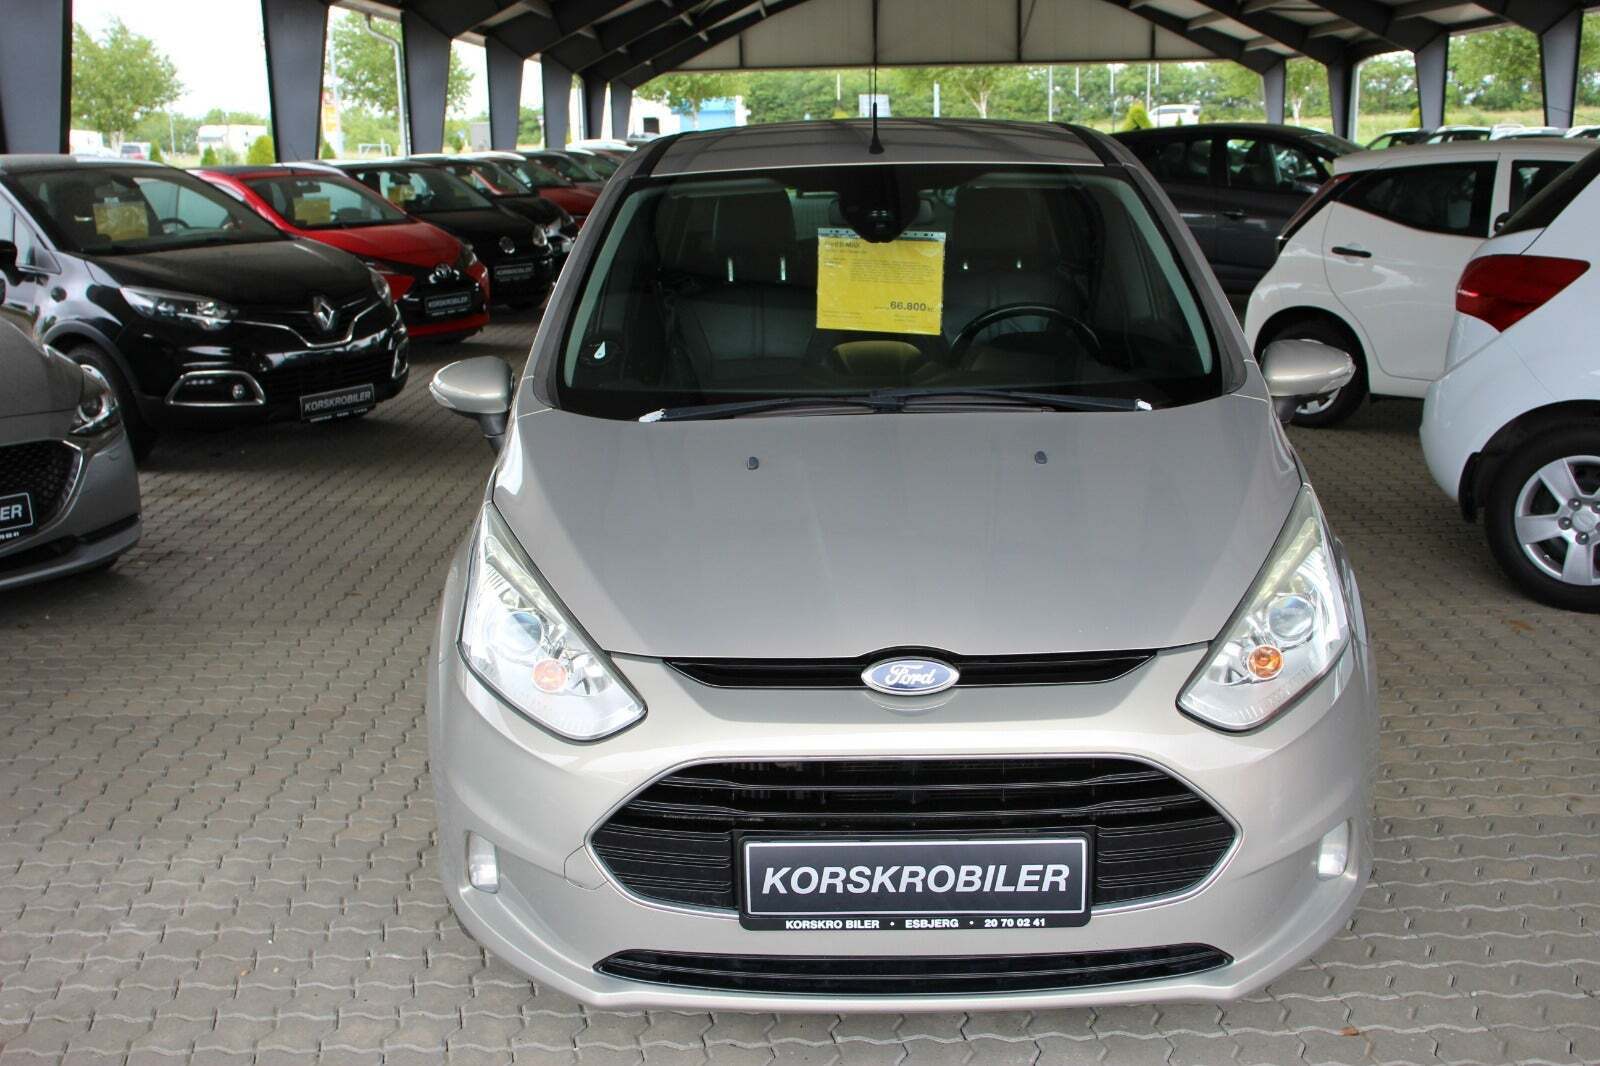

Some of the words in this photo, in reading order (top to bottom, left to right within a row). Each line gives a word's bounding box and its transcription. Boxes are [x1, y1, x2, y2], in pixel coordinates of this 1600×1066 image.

[890, 301, 927, 311] 66.800
[304, 390, 372, 412] KORSKROBILER
[884, 663, 936, 685] Ford
[761, 864, 1070, 895] KORSKROBILER
[785, 919, 843, 930] KORSKRO
[845, 919, 880, 929] BILER
[904, 918, 959, 929] ESBJERG
[984, 918, 999, 928] 20
[1000, 918, 1015, 928] 70
[1016, 918, 1031, 928] 02
[1032, 918, 1045, 927] 41
